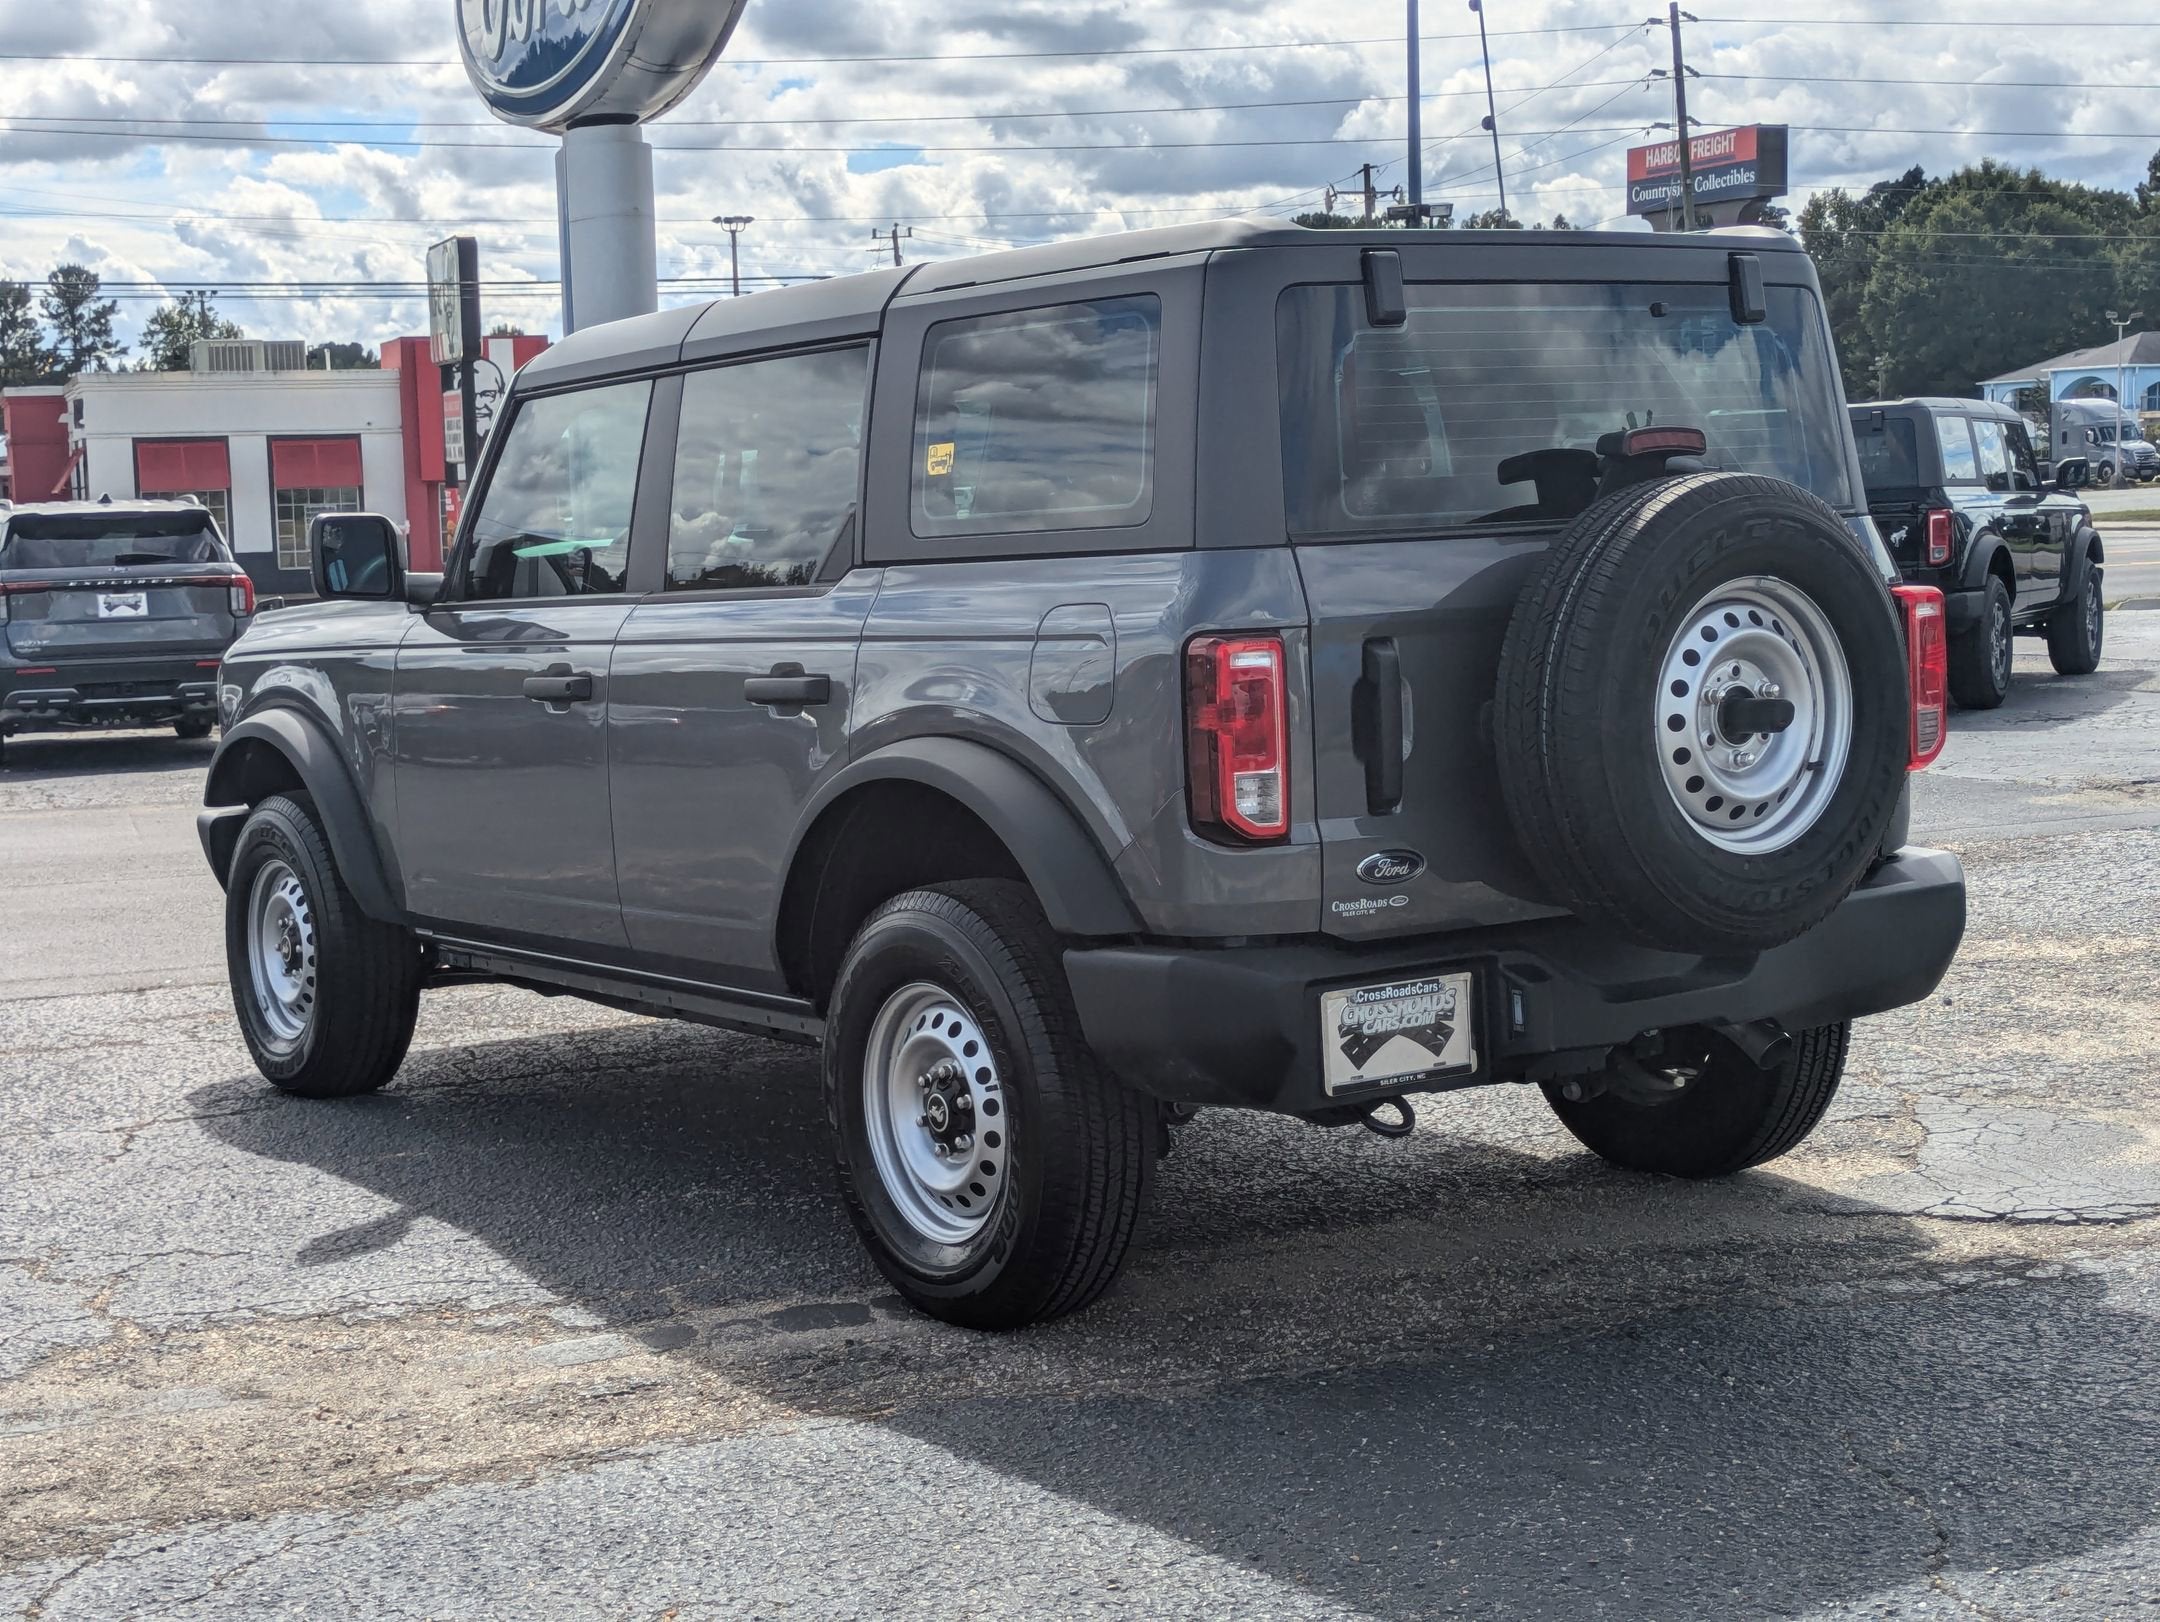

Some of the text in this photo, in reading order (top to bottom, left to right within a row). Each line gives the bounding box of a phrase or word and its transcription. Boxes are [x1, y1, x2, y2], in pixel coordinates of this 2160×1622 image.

[1646, 146, 1685, 168] HARBO
[1691, 132, 1737, 160] FREIGHT
[1632, 167, 1756, 203] Countrysi Collectibles
[68, 578, 173, 587] EXPLORER
[1374, 858, 1410, 878] Ford
[1380, 1077, 1398, 1086] SILER
